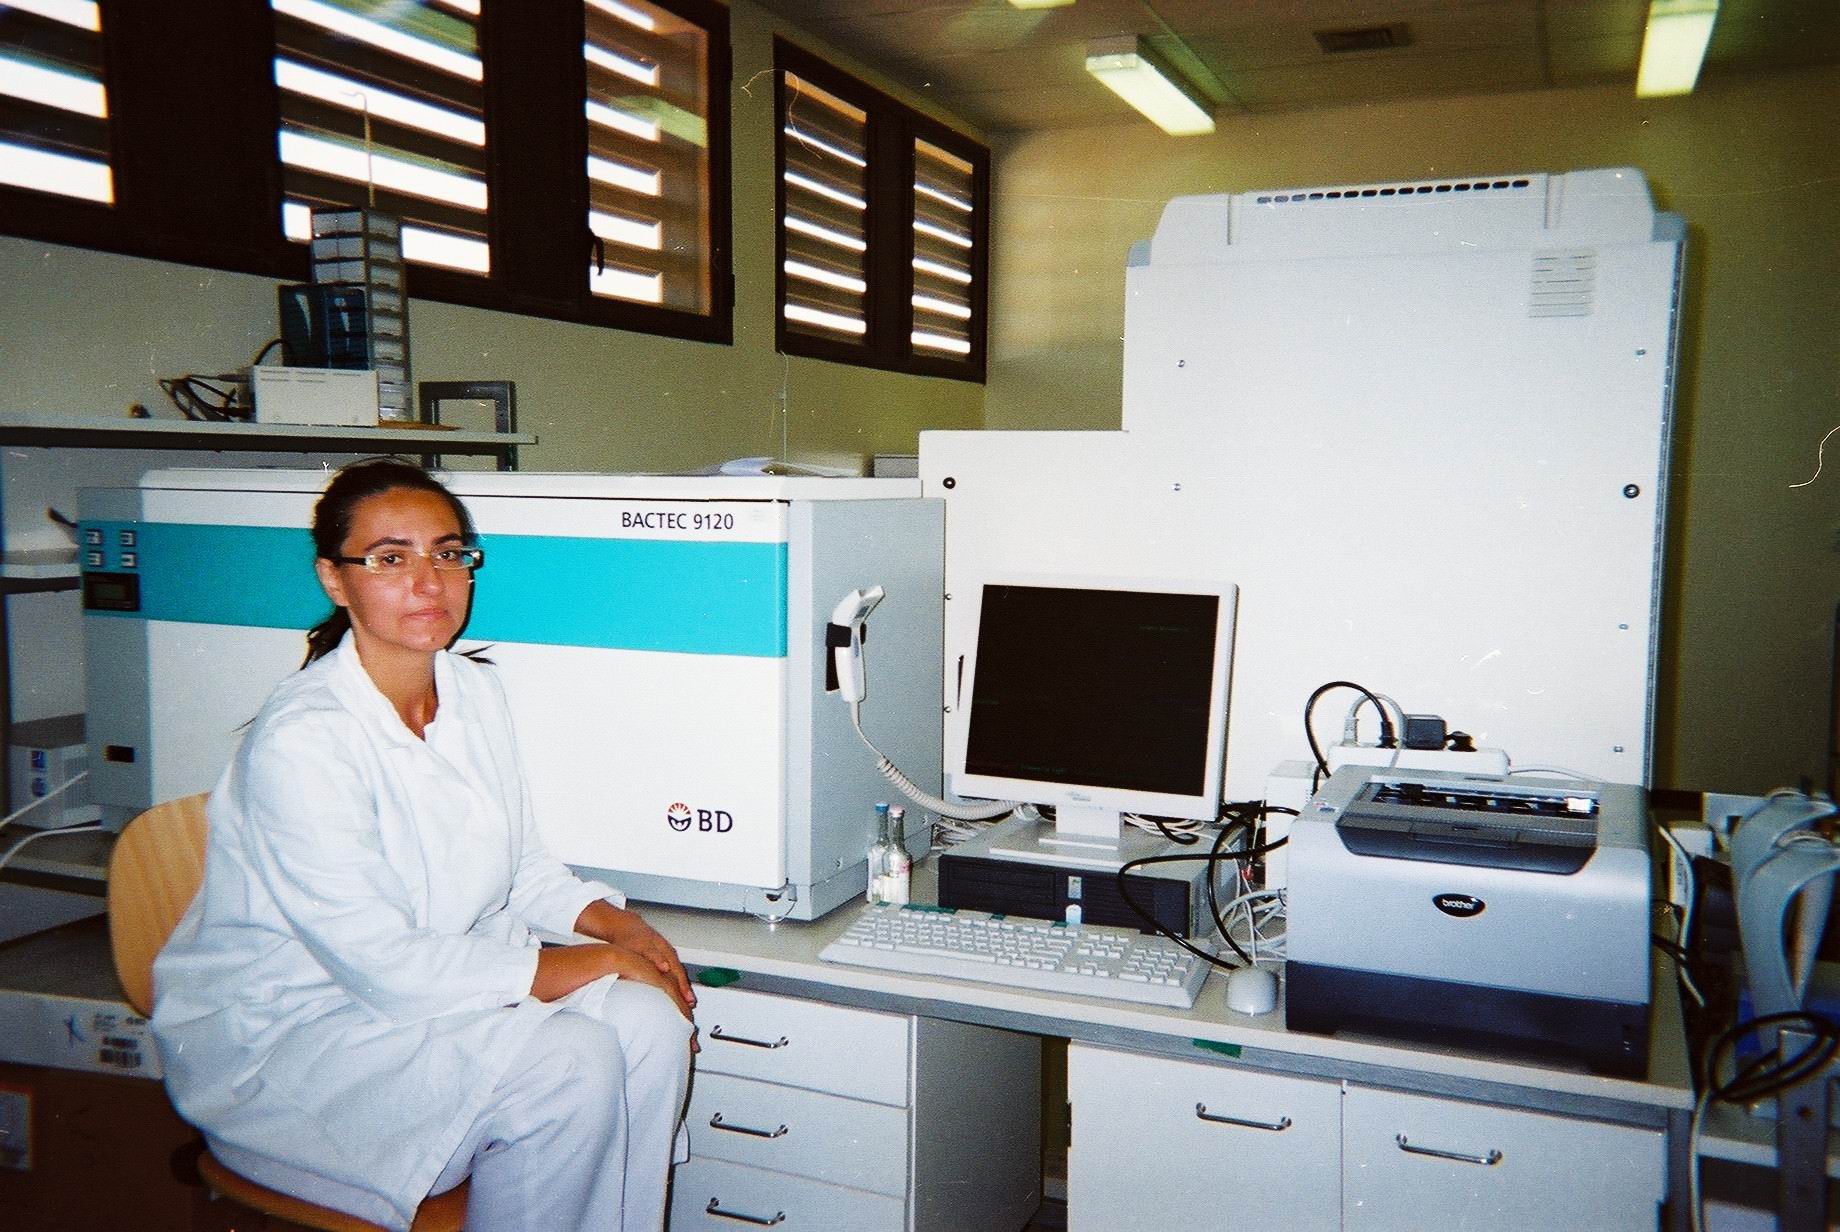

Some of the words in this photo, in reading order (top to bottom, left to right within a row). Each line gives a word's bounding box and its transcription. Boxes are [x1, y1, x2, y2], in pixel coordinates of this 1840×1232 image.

[622, 512, 687, 529] BACTEC
[693, 513, 734, 530] 9120
[697, 809, 733, 833] BD
[1441, 898, 1475, 910] brother
